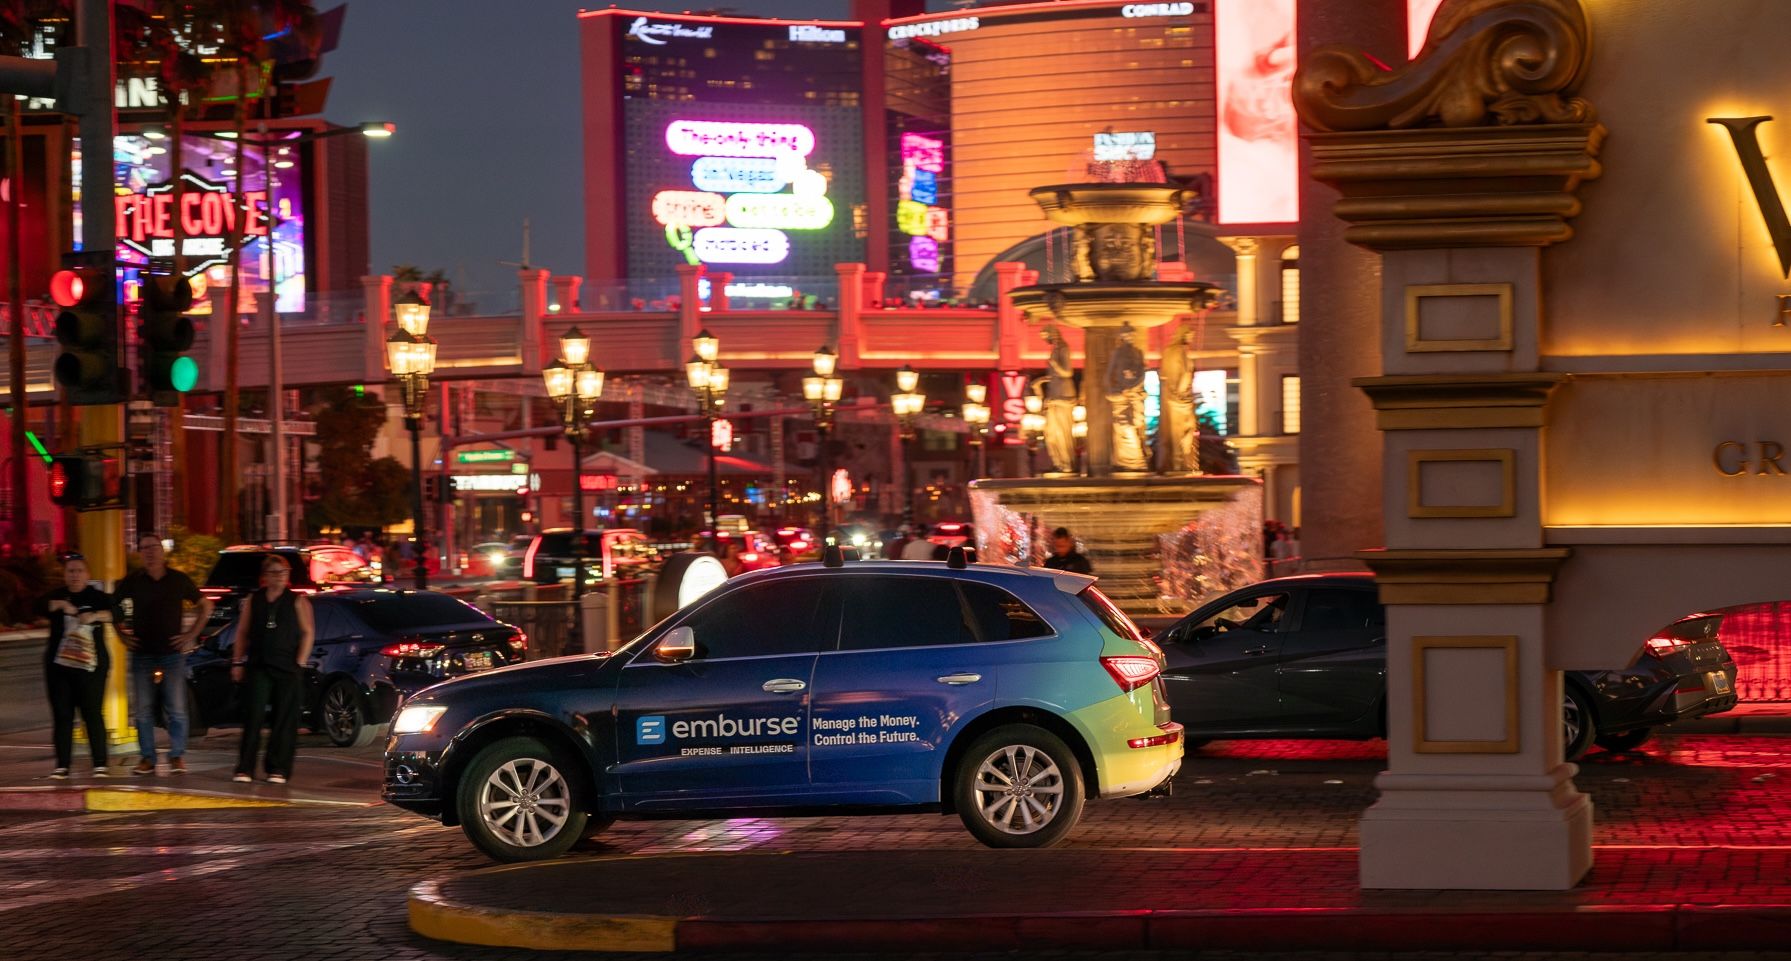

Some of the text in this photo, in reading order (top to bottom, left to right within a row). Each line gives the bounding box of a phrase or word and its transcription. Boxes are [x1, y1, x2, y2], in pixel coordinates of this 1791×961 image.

[1122, 2, 1194, 18] CONRAD
[789, 25, 846, 42] Hilton
[115, 192, 268, 241] THE COVE
[1001, 371, 1027, 421] VS
[672, 713, 799, 739] emburse
[812, 714, 920, 732] Manage the Money.
[814, 730, 920, 746] Control the Future.
[681, 744, 794, 757] EXPENSE INTELLIGENCE
